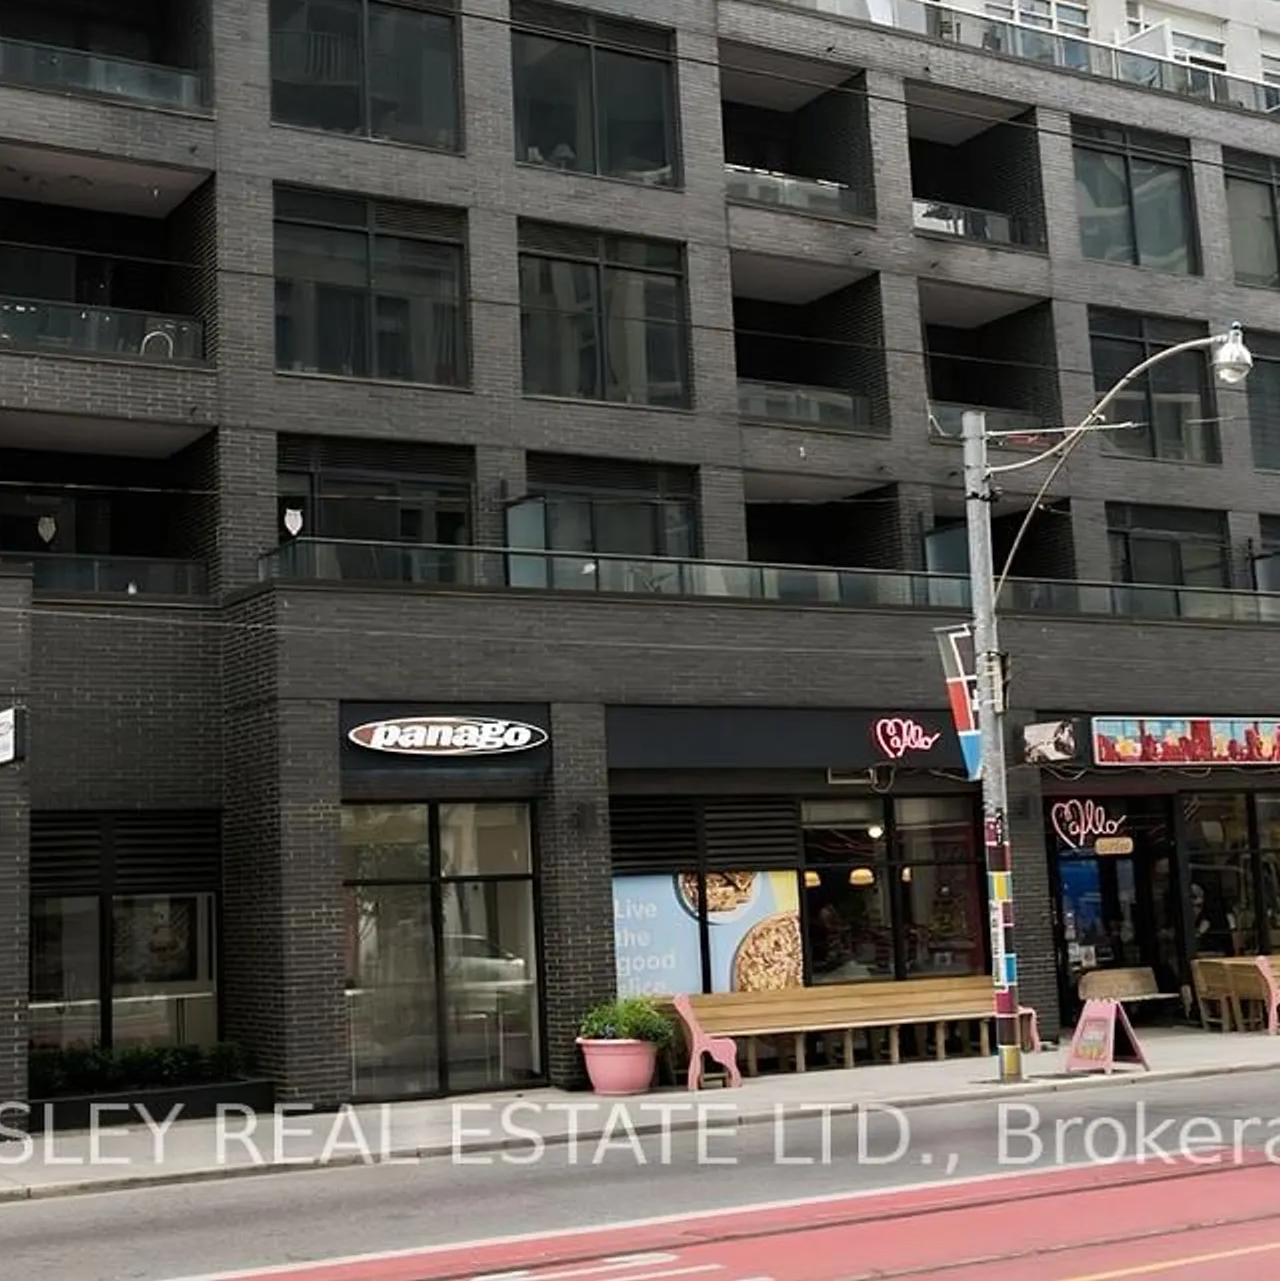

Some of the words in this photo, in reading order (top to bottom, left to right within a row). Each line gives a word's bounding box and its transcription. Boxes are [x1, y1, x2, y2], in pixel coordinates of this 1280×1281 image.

[371, 721, 532, 749] panago
[614, 898, 658, 920] Live
[618, 949, 677, 977] good
